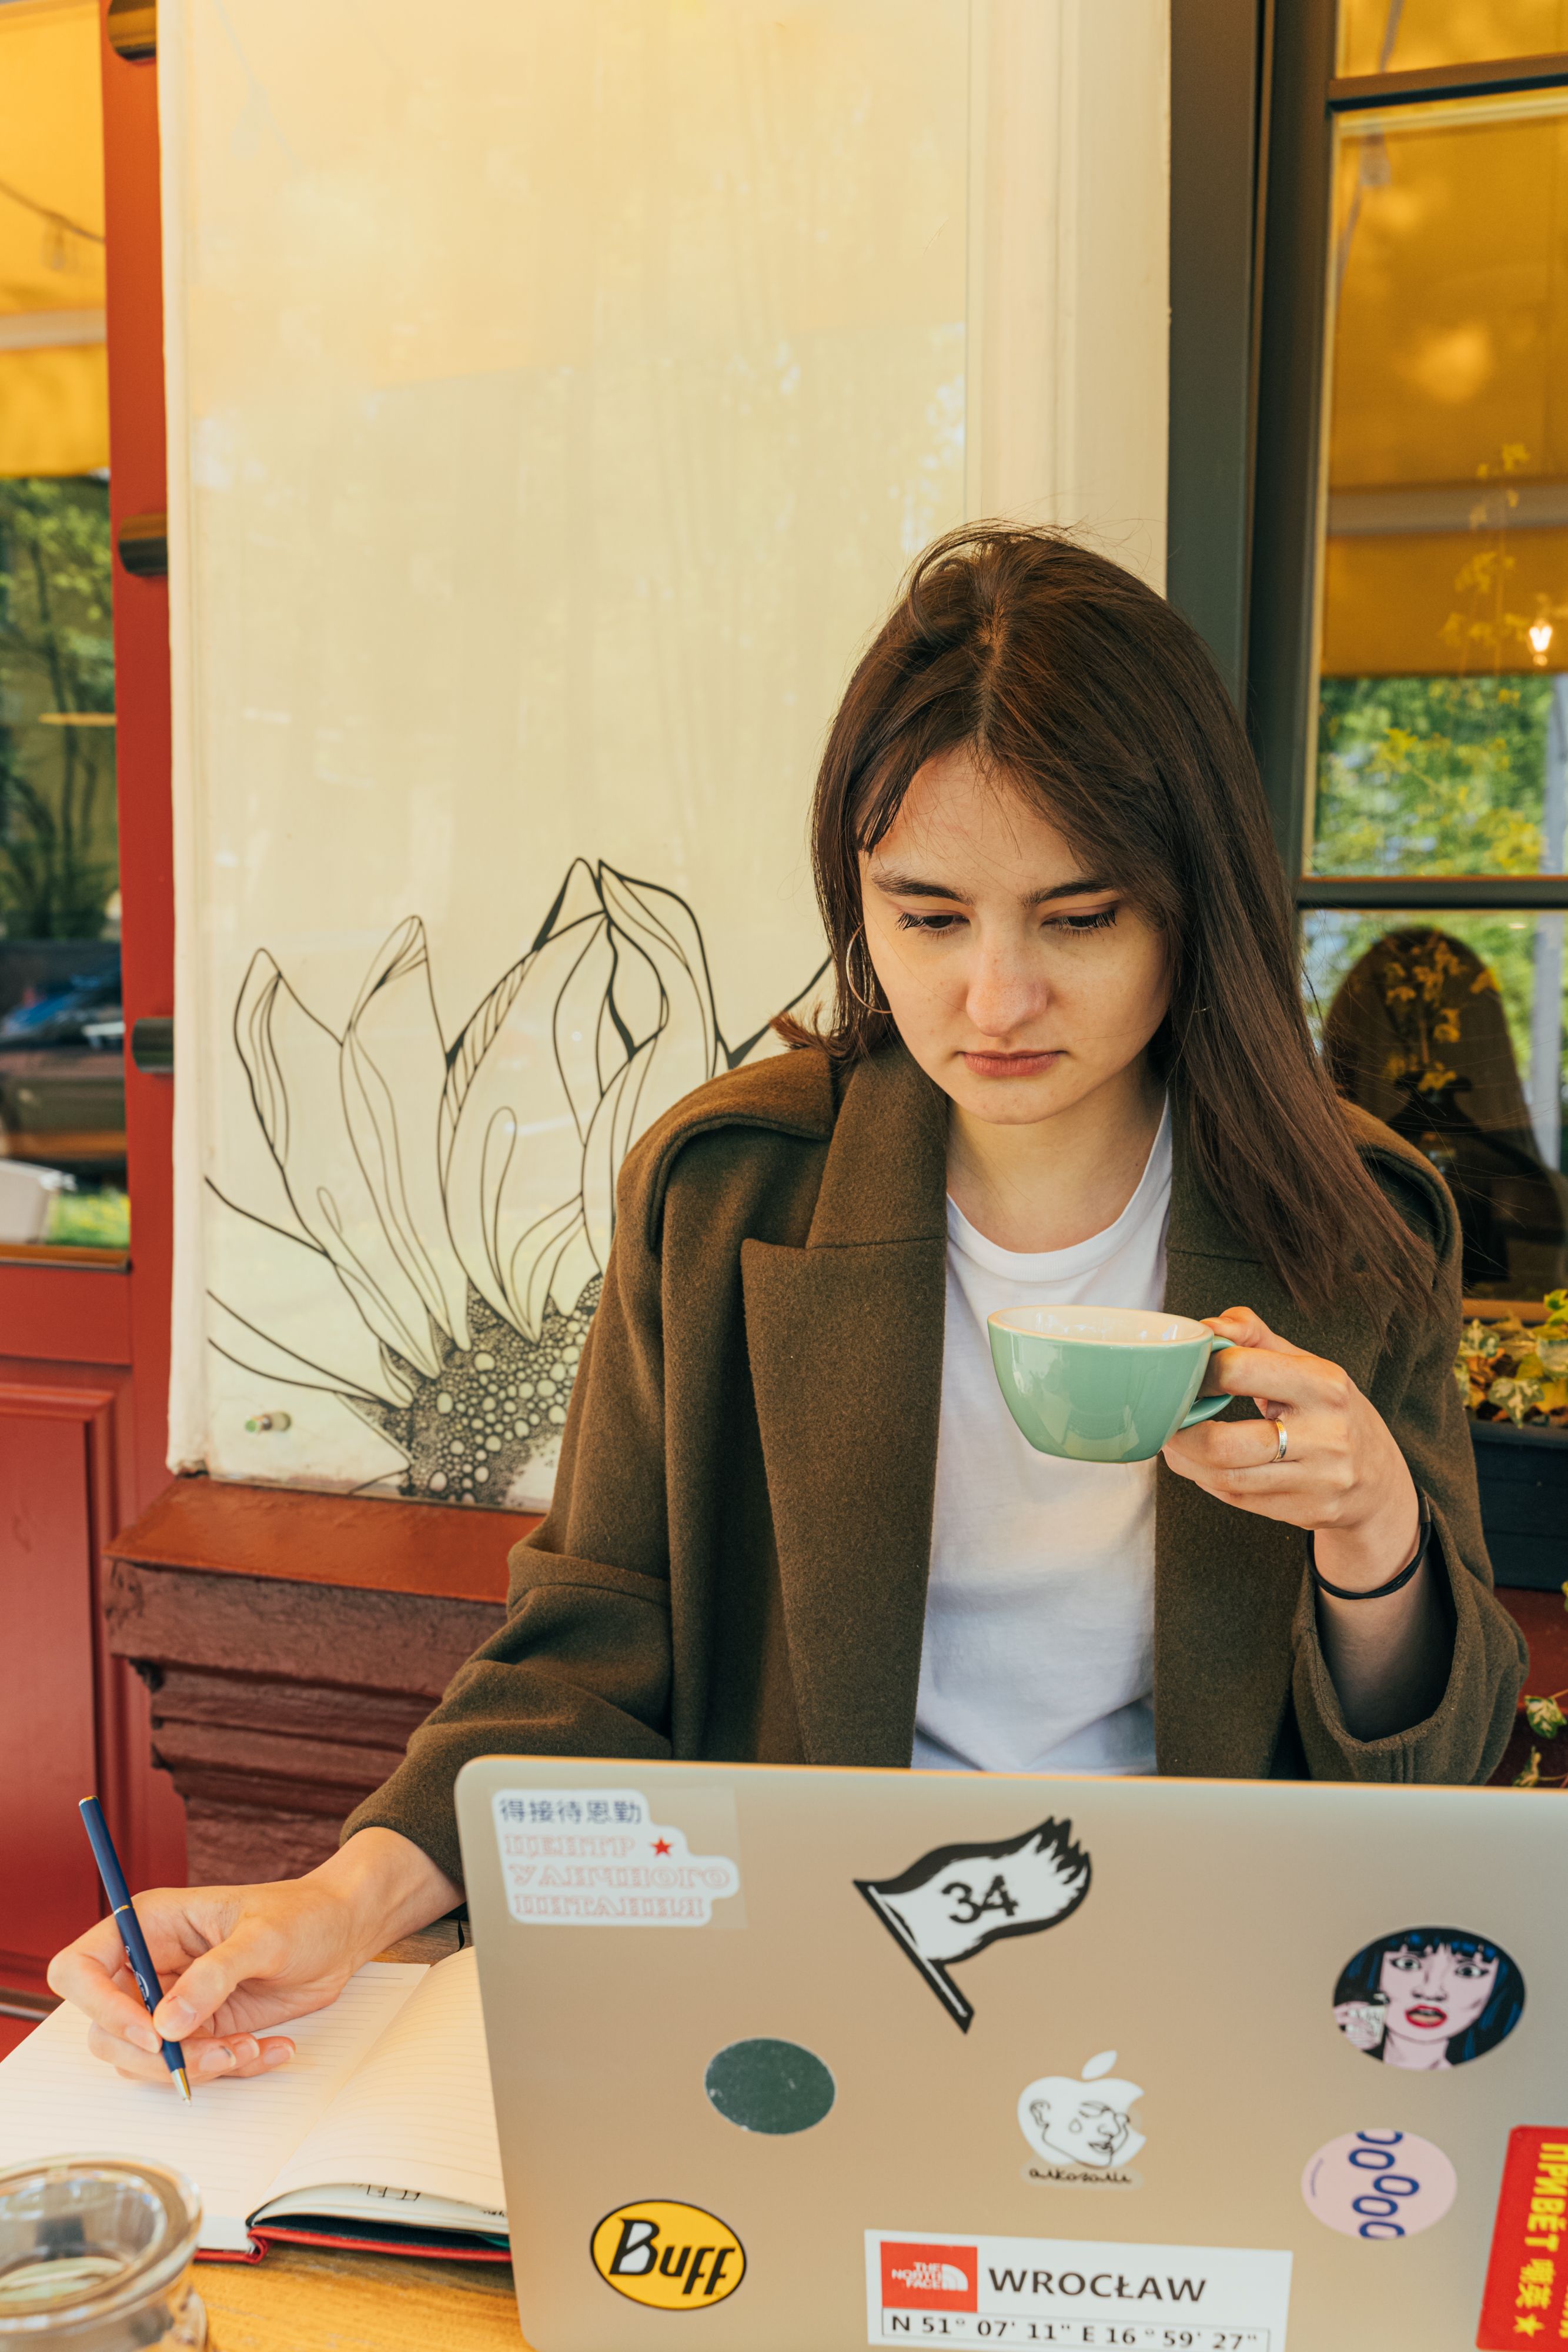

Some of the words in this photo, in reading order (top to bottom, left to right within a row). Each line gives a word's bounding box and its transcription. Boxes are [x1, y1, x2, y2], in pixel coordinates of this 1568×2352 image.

[941, 1874, 1019, 1923] 34
[609, 2218, 736, 2296] Buff
[913, 2261, 941, 2272] THE
[891, 2269, 942, 2282] NORTH
[905, 2277, 942, 2290] FACE
[988, 2267, 1206, 2302] WROCŁAW
[892, 2315, 910, 2331] N
[1082, 2326, 1095, 2343] E
